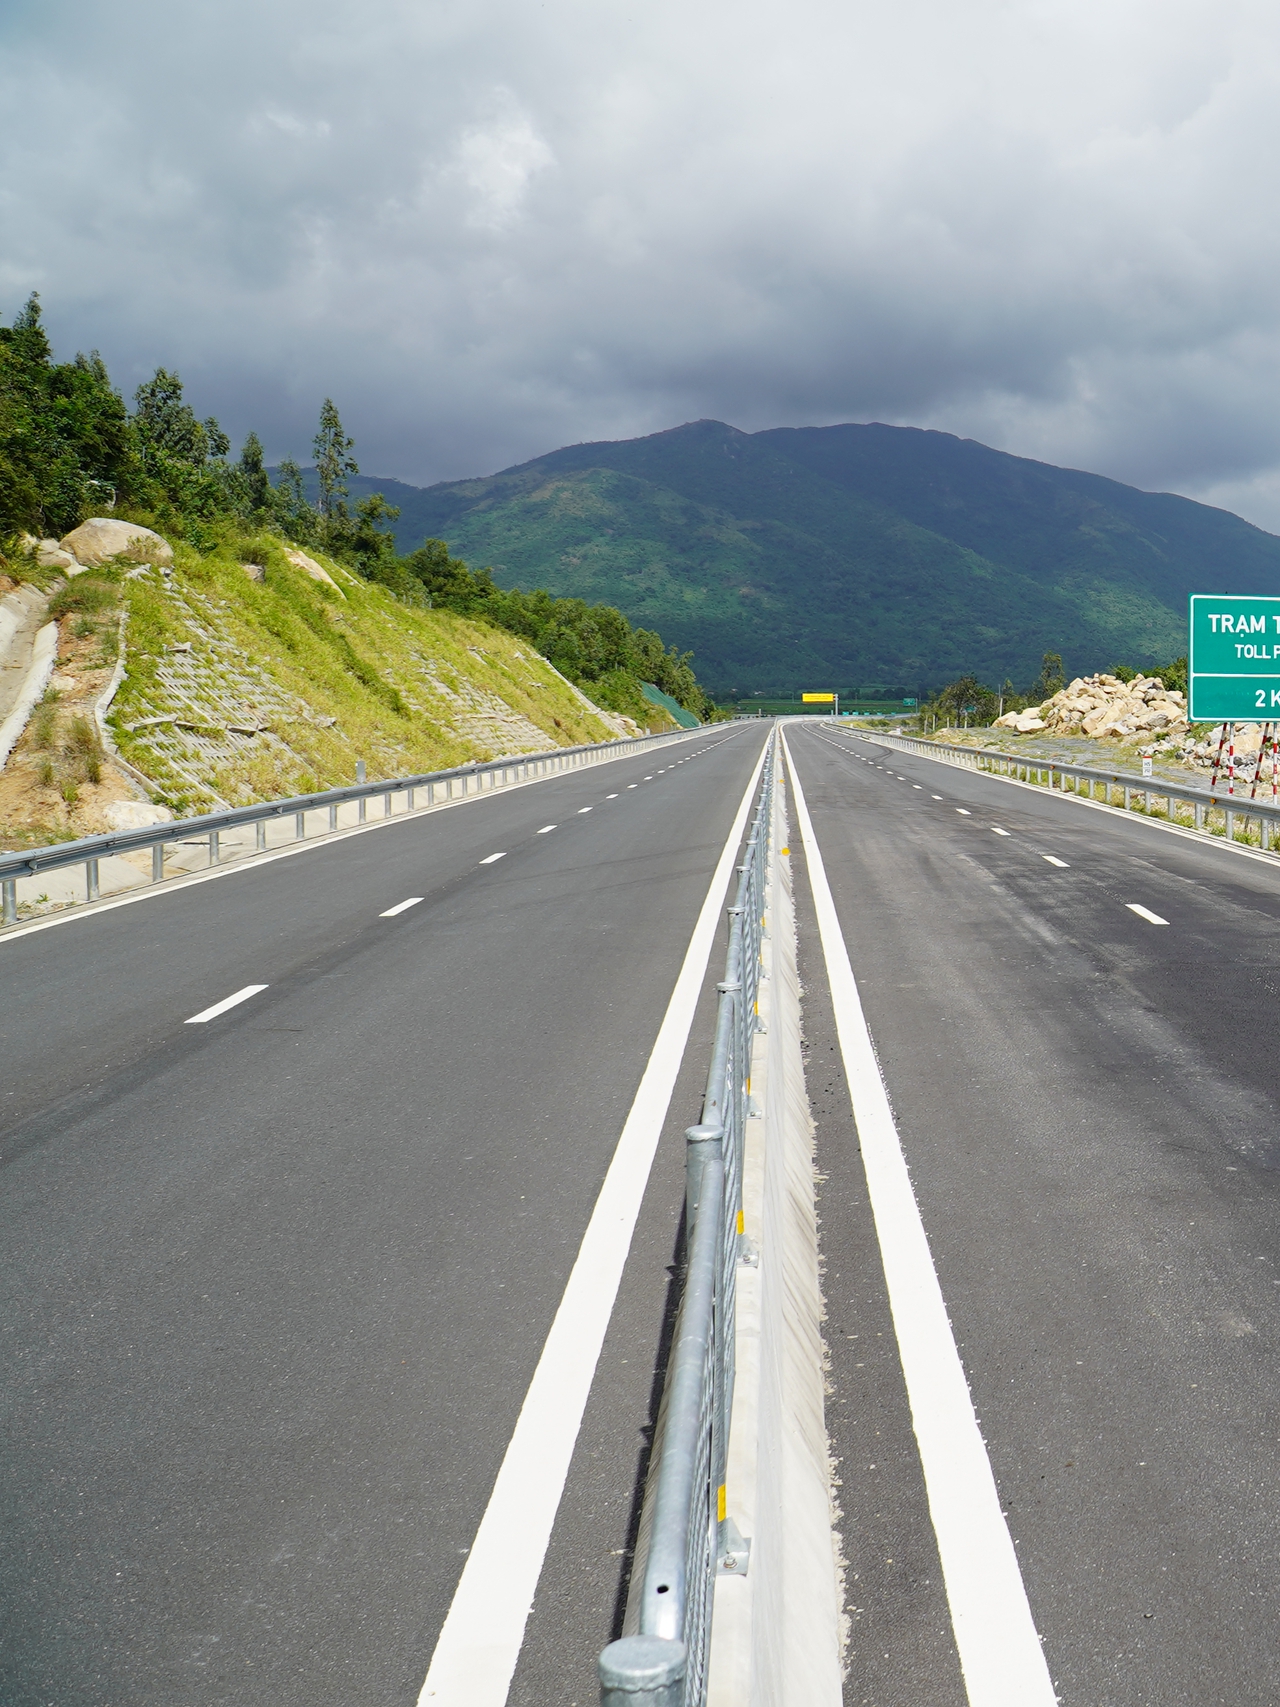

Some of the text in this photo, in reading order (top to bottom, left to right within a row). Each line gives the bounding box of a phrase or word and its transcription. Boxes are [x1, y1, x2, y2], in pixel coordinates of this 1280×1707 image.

[1207, 614, 1266, 638] TRẠM
[1234, 643, 1271, 659] TOLL
[1255, 689, 1266, 708] 2
